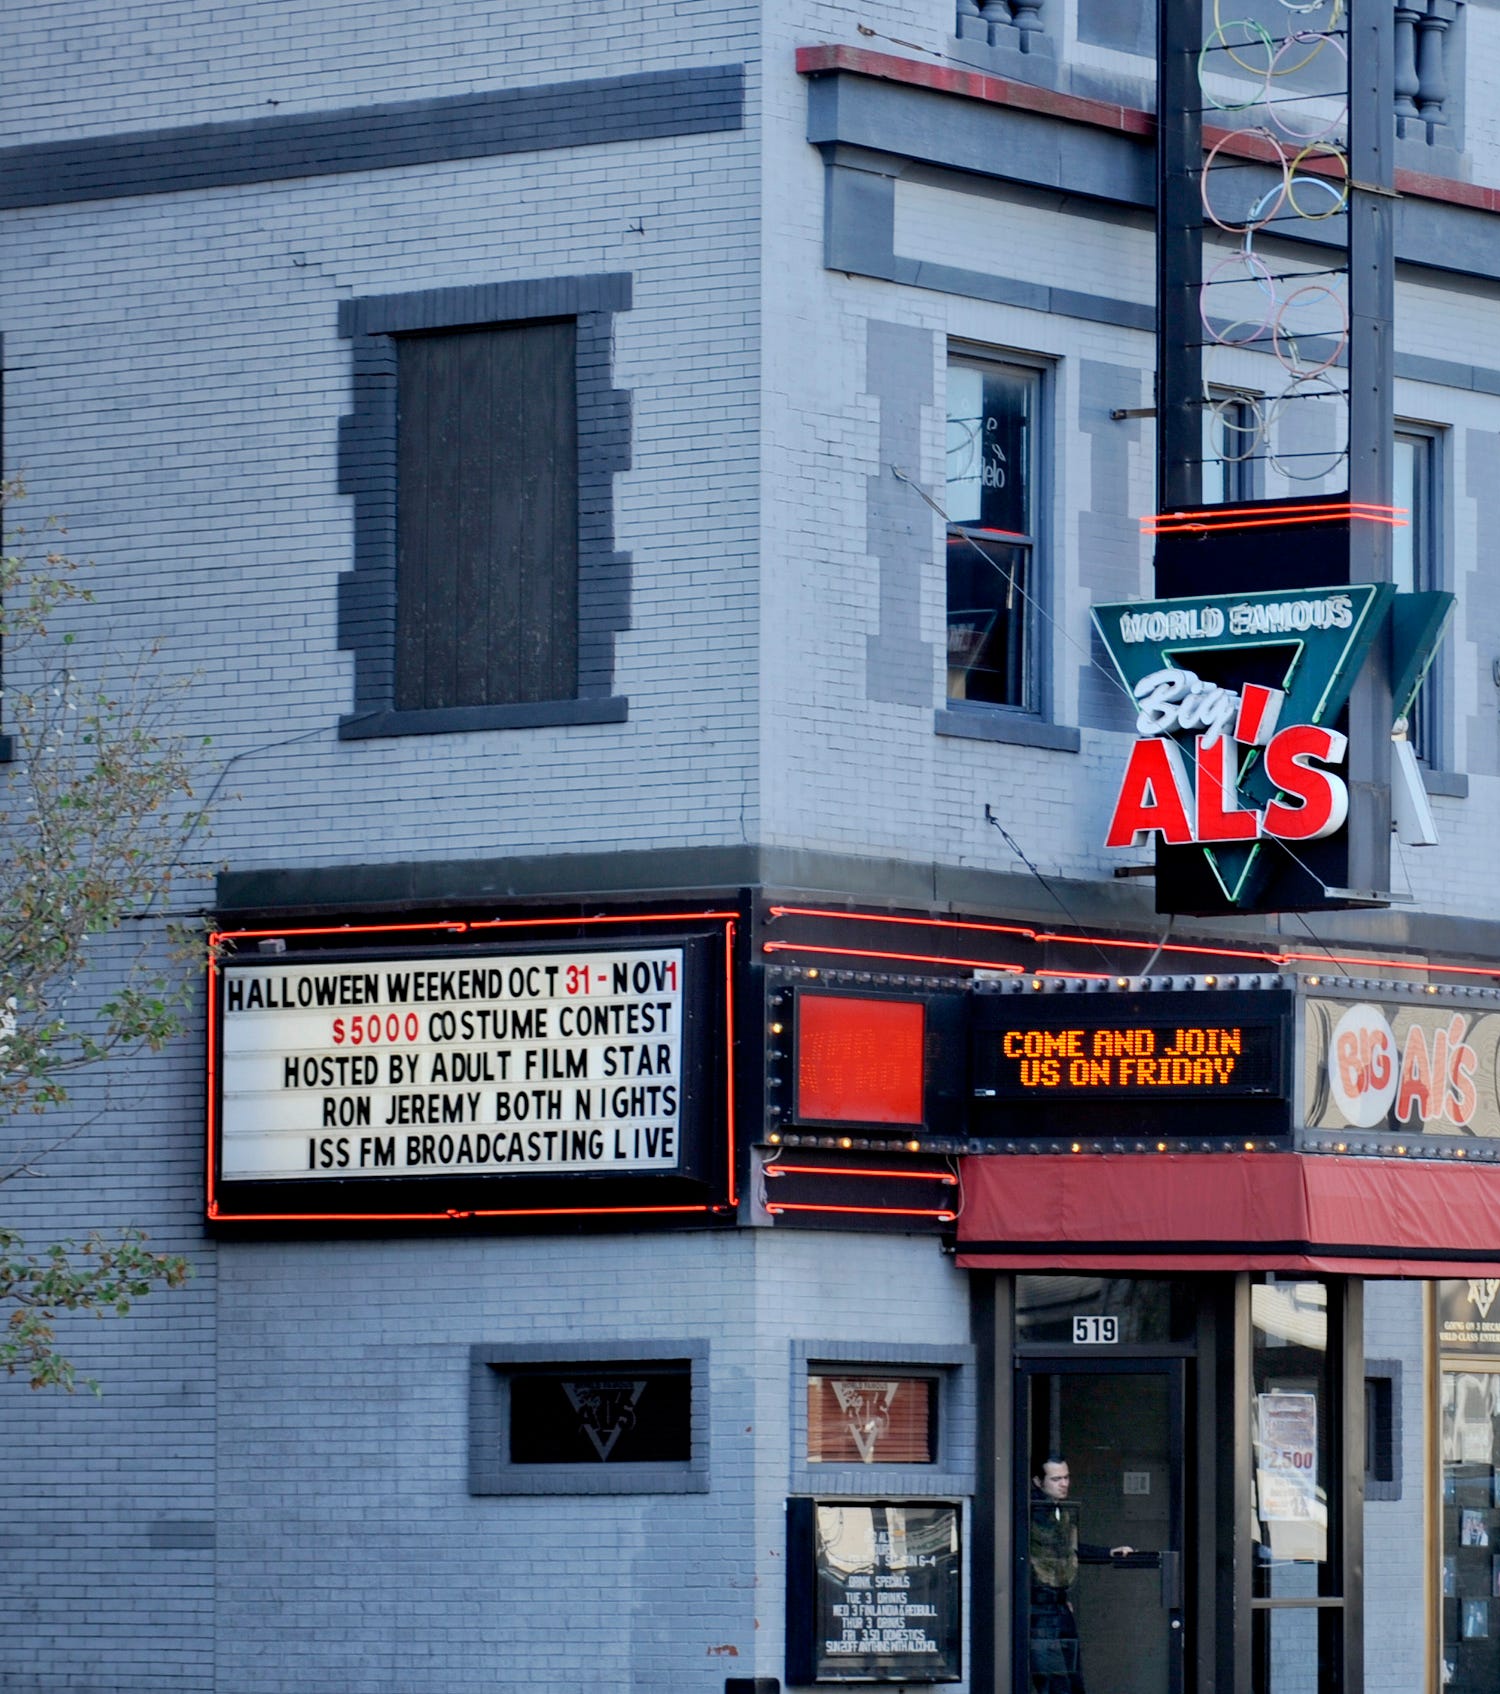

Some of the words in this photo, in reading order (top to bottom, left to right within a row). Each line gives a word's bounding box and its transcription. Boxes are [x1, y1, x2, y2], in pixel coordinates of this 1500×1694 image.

[1119, 606, 1224, 643] WORLD
[1229, 593, 1353, 635] FAMOUS
[1135, 668, 1241, 749] Big
[1104, 682, 1349, 848] AL'S
[228, 974, 379, 1012] HALLOWEEN
[387, 969, 502, 1003] WEEKEND
[508, 966, 559, 998] OCT
[332, 1012, 419, 1045] $5000
[429, 1008, 548, 1042] COSTUME
[559, 1002, 672, 1037] CONTEST
[1003, 1030, 1085, 1058] COME
[1093, 1029, 1155, 1057] AND
[1164, 1028, 1241, 1055] JOIN
[284, 1055, 378, 1088] HOSTED
[389, 1054, 419, 1085] BY
[430, 1050, 511, 1083] ADULT
[525, 1047, 588, 1080] FILM
[603, 1044, 671, 1077] STAR
[1019, 1059, 1061, 1086] US
[1069, 1058, 1111, 1086] ON
[1118, 1057, 1235, 1086] FRIDAY
[1337, 1027, 1391, 1099] BIG
[322, 1096, 371, 1128] RON
[385, 1092, 481, 1125] JEREMY
[496, 1089, 562, 1122] BOTH
[576, 1085, 677, 1121] NIGHTS
[360, 1136, 395, 1168] FM
[406, 1129, 604, 1166] BROADCASTING
[614, 1127, 674, 1160] LIVE
[1076, 1318, 1116, 1342] 519
[832, 1605, 850, 1616] WED
[851, 1605, 859, 1616] 3
[845, 1592, 862, 1604] TUE
[865, 1592, 873, 1604] 3
[877, 1592, 908, 1604] DRINKS
[842, 1617, 864, 1628] THUR
[865, 1617, 873, 1628] 3
[877, 1617, 906, 1628] DRINKS
[842, 1629, 856, 1641] FRI
[883, 1629, 926, 1640] DOMESTICS
